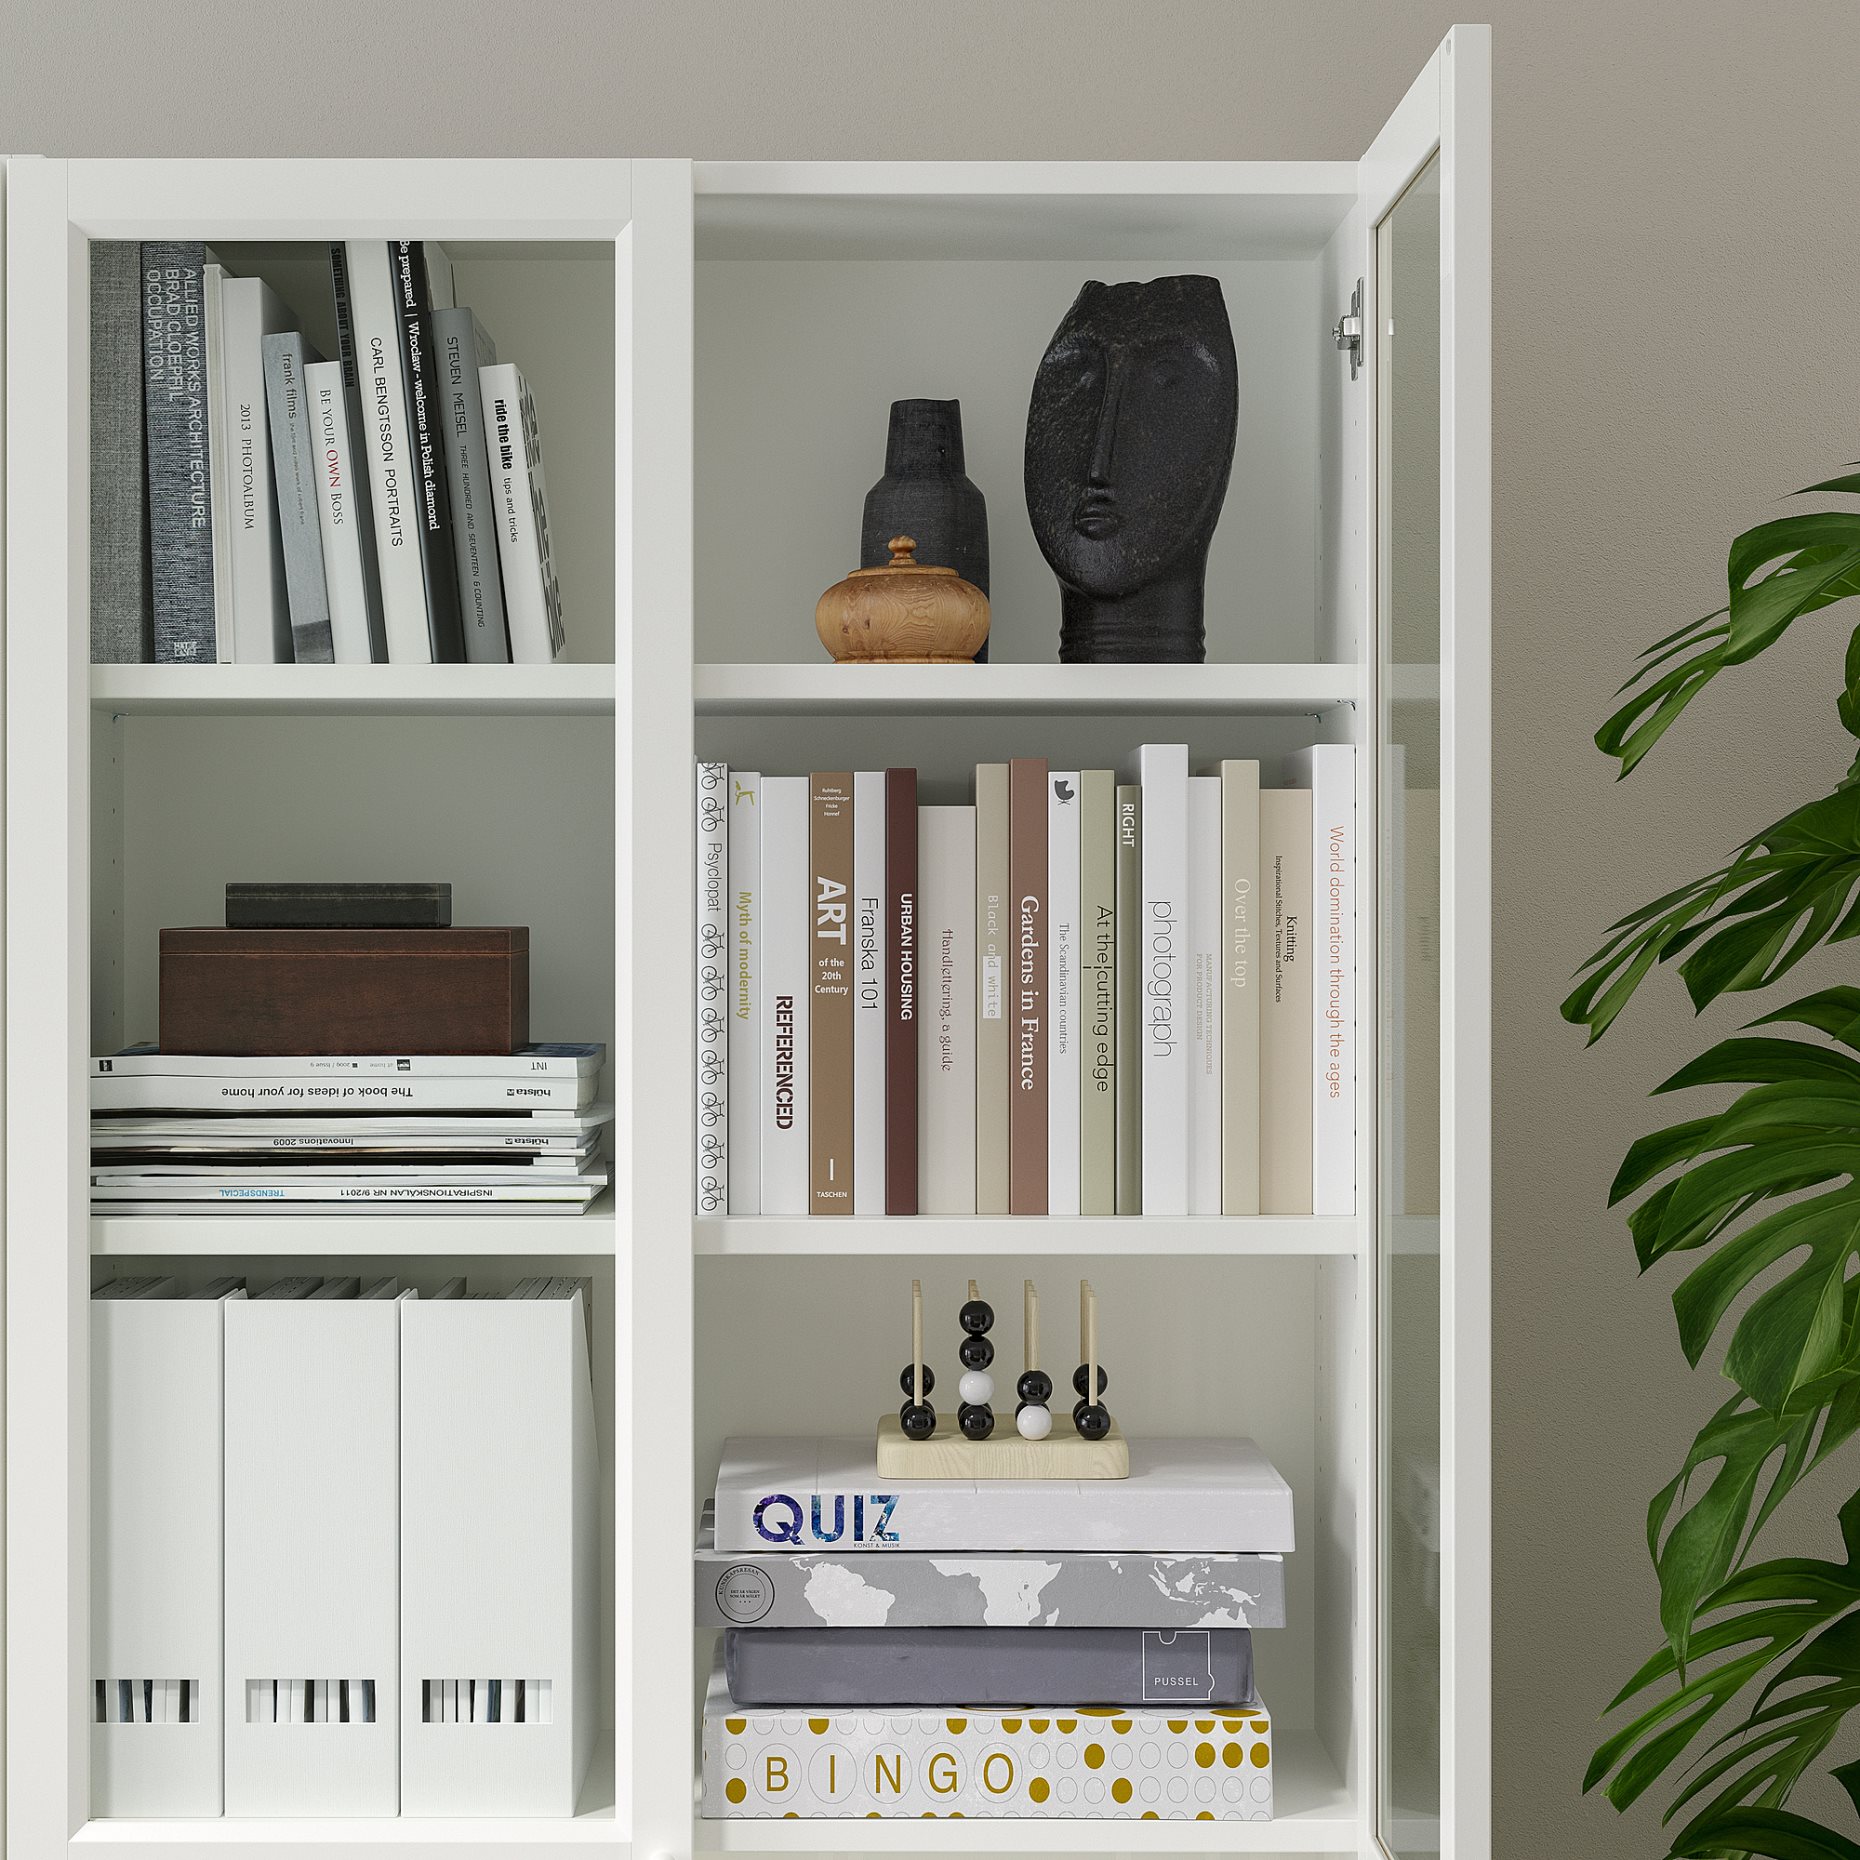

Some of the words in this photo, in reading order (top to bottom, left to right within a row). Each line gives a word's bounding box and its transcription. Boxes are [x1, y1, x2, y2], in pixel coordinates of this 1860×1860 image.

[331, 248, 345, 298] SOMETHING
[398, 255, 416, 308] prepared
[166, 269, 181, 315] BRAD
[184, 268, 198, 326] ALLIED
[337, 301, 349, 330] ABOUT
[186, 331, 201, 391] WORKS
[340, 333, 352, 357] YOUR
[370, 336, 385, 373] CARL
[408, 322, 421, 372] Wroclaw
[447, 336, 461, 384] STEVEN
[282, 353, 295, 385] frank
[343, 360, 355, 388] BRAIN
[286, 388, 298, 418] films
[320, 389, 331, 405] BE
[414, 379, 426, 430] welcome
[494, 399, 507, 422] ride
[240, 404, 251, 430] 2013
[321, 407, 335, 447] YOUR
[374, 377, 394, 462] BENGTSSON
[453, 392, 467, 437] MEISEL
[420, 432, 430, 444] in
[498, 424, 509, 443] the
[189, 396, 206, 528] ARCHITECTURE
[326, 450, 341, 488] OWN
[420, 444, 434, 478] Polish
[460, 445, 469, 469] THREE
[500, 445, 513, 470] bike
[241, 438, 255, 530] PHOTOALBUM
[462, 473, 472, 509] HUNDRED
[503, 478, 513, 494] tips
[331, 493, 344, 525] BOSS
[385, 468, 403, 546] PORTRAITS
[425, 480, 440, 530] diamond
[466, 512, 475, 529] AND
[506, 497, 516, 514] and
[508, 517, 518, 543] tricks
[468, 533, 479, 576] SEVENTEEN
[473, 588, 485, 627] COUNTING
[1122, 803, 1135, 848] RIGHT
[1330, 826, 1344, 872] World
[708, 843, 722, 911] Psyclopat
[1274, 855, 1283, 899] Inspirational
[736, 891, 752, 927] Myth
[817, 875, 846, 945] ART
[987, 895, 999, 936] Black
[1097, 905, 1113, 927] At
[1235, 878, 1251, 922] Over
[861, 898, 879, 970] Franska
[900, 893, 912, 949] URBAN
[1059, 922, 1069, 941] The
[1330, 878, 1344, 963] domination
[739, 933, 752, 945] of
[1021, 896, 1039, 983] Gardens
[1097, 933, 1114, 963] the
[1235, 926, 1250, 951] the
[1275, 929, 1283, 958] Textures
[1283, 915, 1297, 962] Knitting
[818, 957, 829, 967] of
[830, 957, 845, 967] the
[987, 943, 999, 968] and
[1230, 956, 1247, 988] top
[1275, 960, 1283, 973] and
[736, 948, 752, 1020] modernity
[814, 985, 849, 995] Century
[821, 970, 842, 981] 20th
[900, 952, 912, 1020] HOUSING
[1059, 944, 1069, 1007] Scandinavian
[1148, 902, 1177, 1056] photograph
[1275, 975, 1283, 1003] Surfaces
[861, 979, 878, 1009] 101
[987, 976, 1000, 1017] white
[1022, 990, 1040, 1011] in
[1093, 970, 1113, 1036] cutting
[1326, 969, 1344, 1028] through
[942, 1024, 951, 1032] a
[1059, 1009, 1069, 1054] countries
[939, 1035, 953, 1071] guide
[1022, 1017, 1038, 1089] France
[1330, 1033, 1341, 1057] the
[531, 1062, 547, 1071] INT
[776, 995, 793, 1129] REFERENCED
[1093, 1042, 1114, 1092] edge
[221, 1087, 255, 1097] home
[257, 1086, 285, 1095] your
[287, 1088, 304, 1097] for
[308, 1087, 340, 1097] ideas
[342, 1087, 354, 1097] of
[358, 1087, 388, 1097] book
[391, 1087, 413, 1097] The
[516, 1088, 551, 1096] hülsta
[1326, 1063, 1339, 1098] ages
[273, 1138, 297, 1146] 2009
[299, 1138, 354, 1146] Innovations
[219, 1189, 285, 1197] TRENDSPECIAL
[340, 1189, 370, 1197] 9/2011
[373, 1189, 387, 1197] NR
[752, 1494, 900, 1545] QUIZ
[1154, 1677, 1199, 1686] PUSSEL
[766, 1752, 1014, 1794] BINGO
